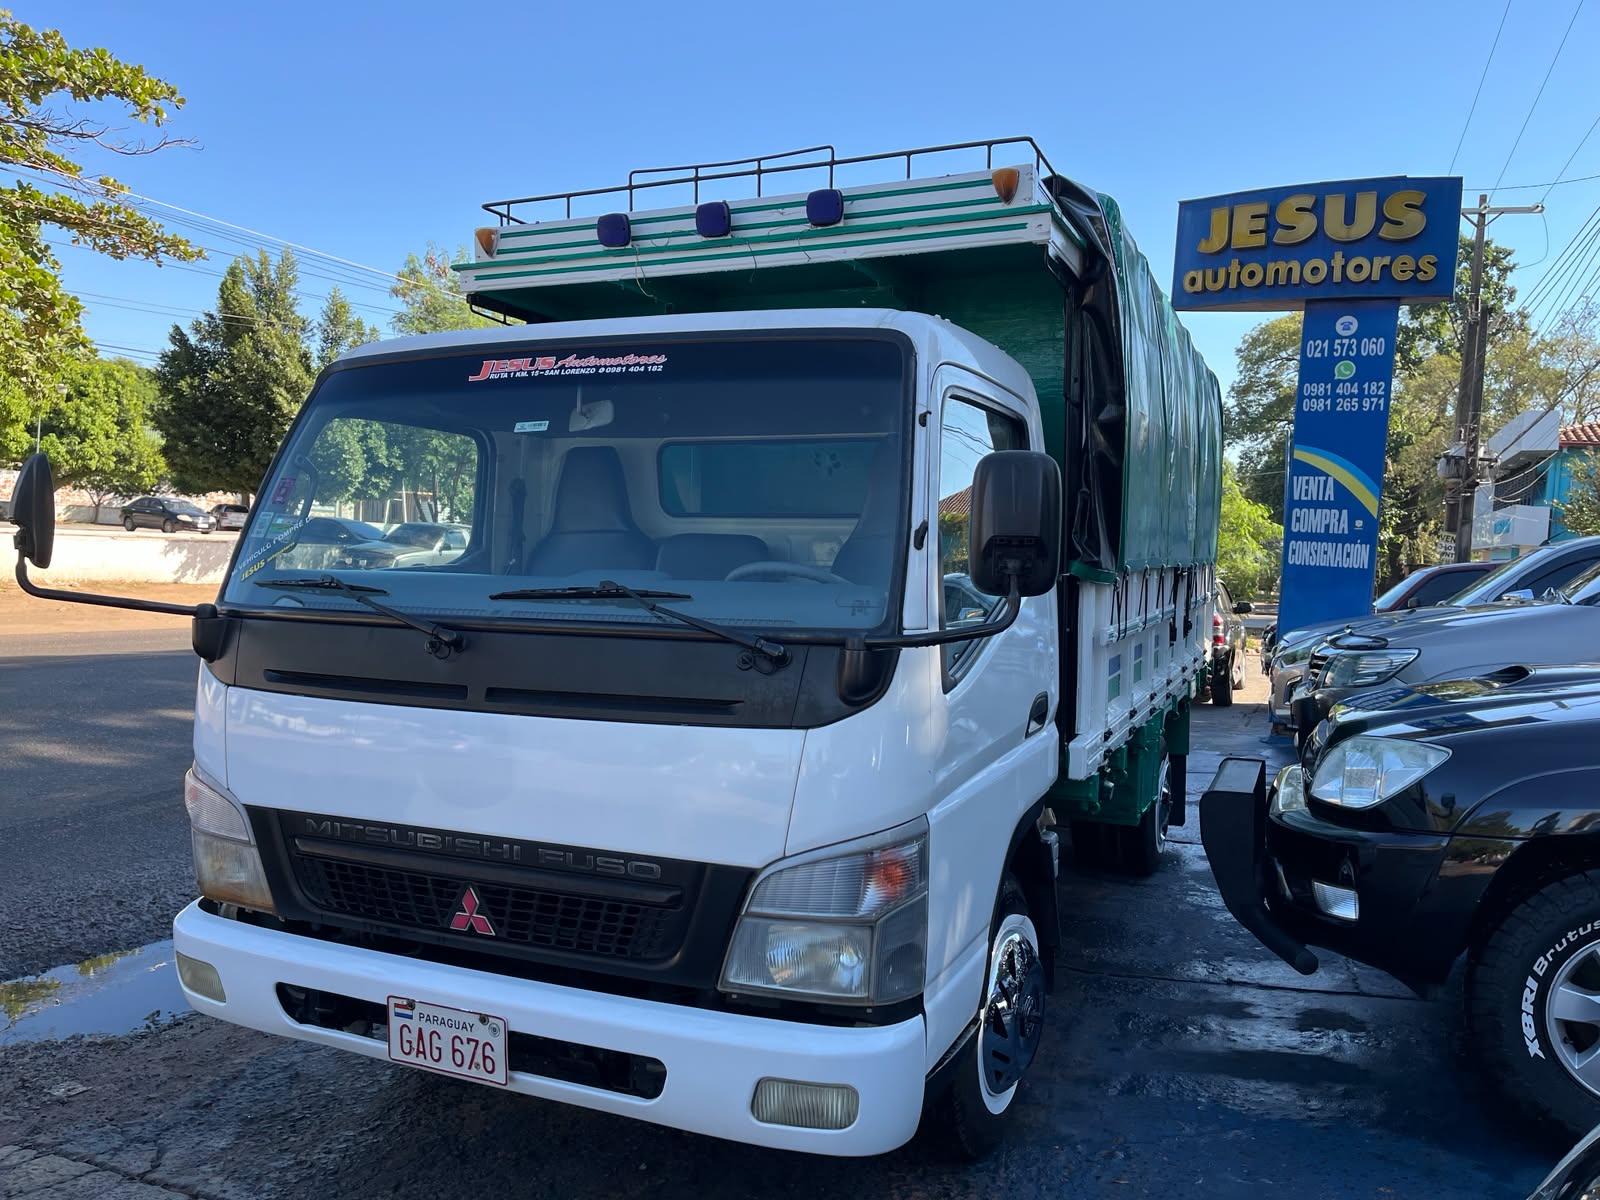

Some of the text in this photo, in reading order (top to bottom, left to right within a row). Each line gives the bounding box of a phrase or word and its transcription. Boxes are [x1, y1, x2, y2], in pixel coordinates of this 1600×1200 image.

[1197, 190, 1427, 255] JESUS
[1182, 251, 1438, 295] automotores
[1306, 338, 1385, 358] 021 573 060
[468, 353, 668, 381] JESUS Automotores
[489, 371, 508, 380] RUTA
[561, 367, 596, 376] LORENZO
[647, 364, 663, 372] 182
[1303, 381, 1385, 397] 0981 404 182
[1302, 397, 1385, 411] 0981 265 971
[1292, 475, 1335, 501] VENTA
[1291, 508, 1349, 535] COMPRA
[1288, 539, 1370, 569] CONSIGNACIÓN
[240, 559, 265, 582] JESUS
[304, 817, 661, 880] MITSUBISHI FUSO
[418, 1012, 475, 1033] PARAGUAY
[1521, 975, 1546, 1060] XBRI
[399, 1023, 496, 1075] GAG 676
